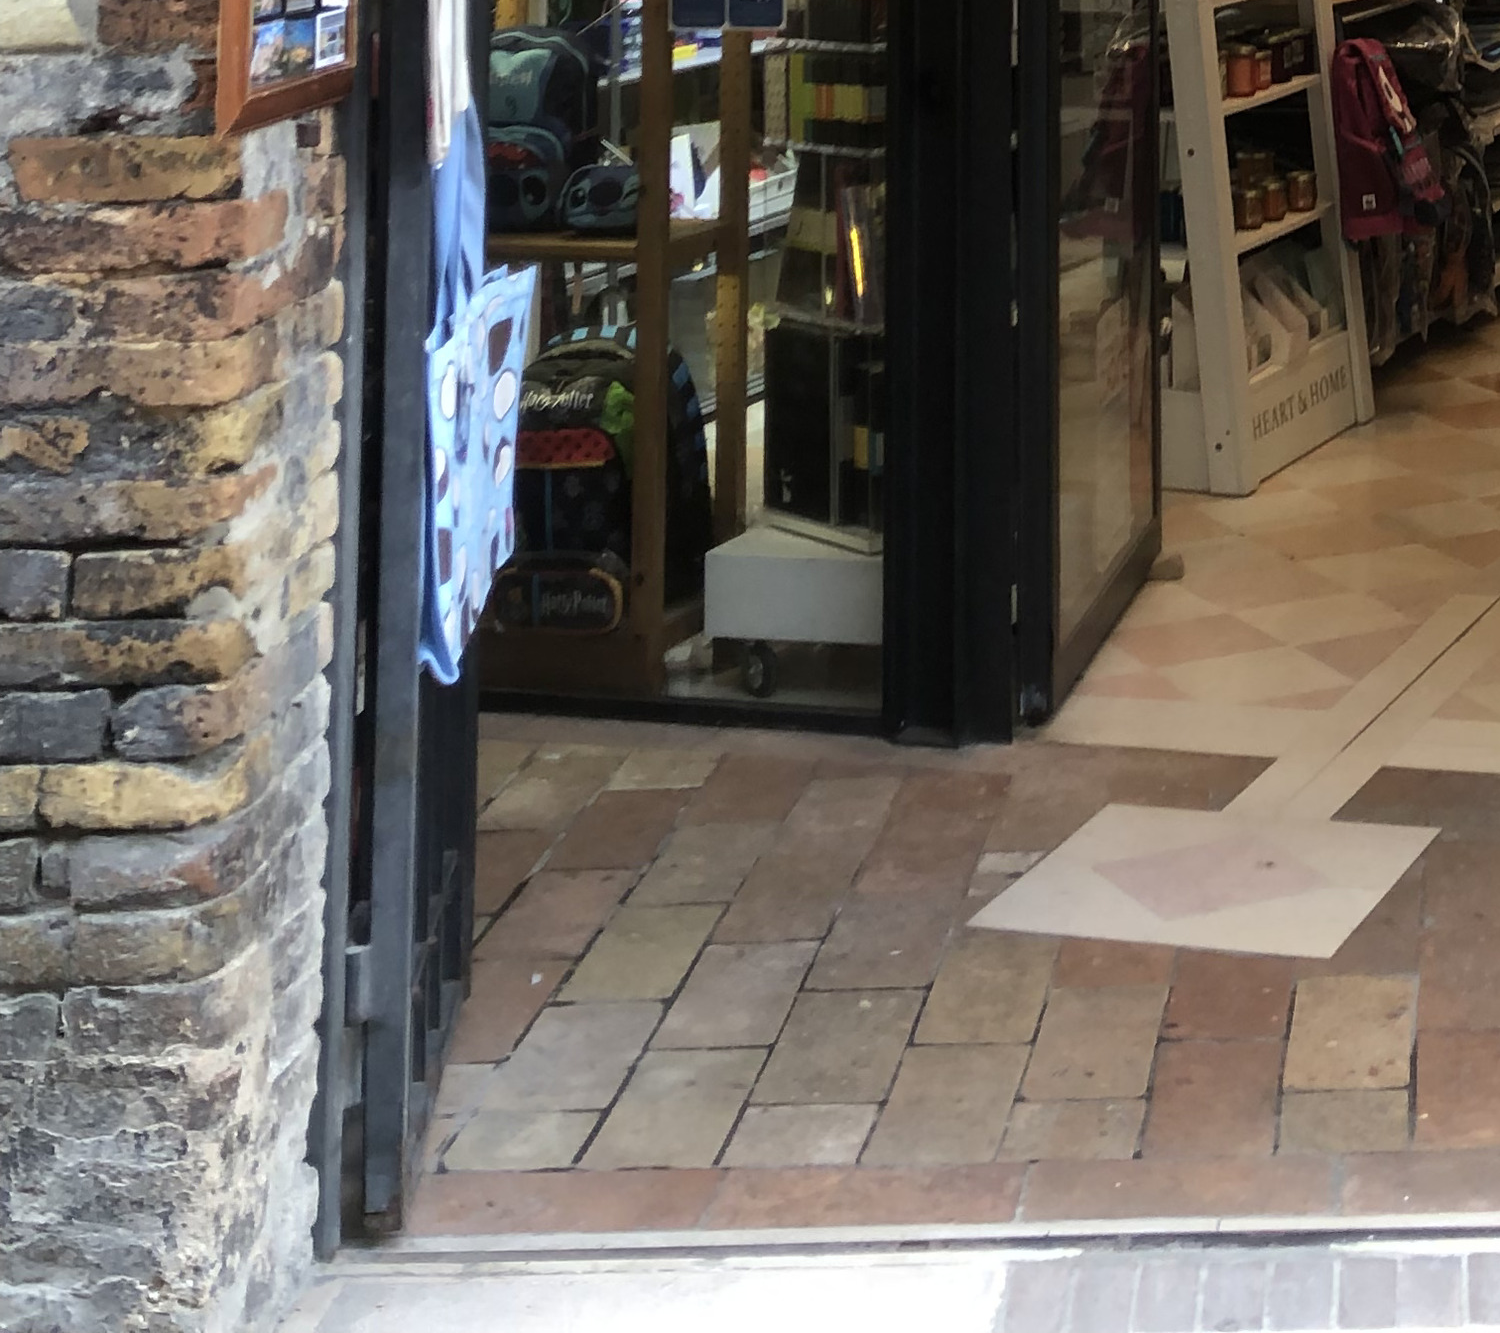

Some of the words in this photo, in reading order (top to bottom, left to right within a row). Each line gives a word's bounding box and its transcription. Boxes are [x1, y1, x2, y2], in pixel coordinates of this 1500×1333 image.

[1253, 395, 1293, 441] HEART
[1299, 390, 1308, 415] &
[1310, 366, 1347, 407] HOME
